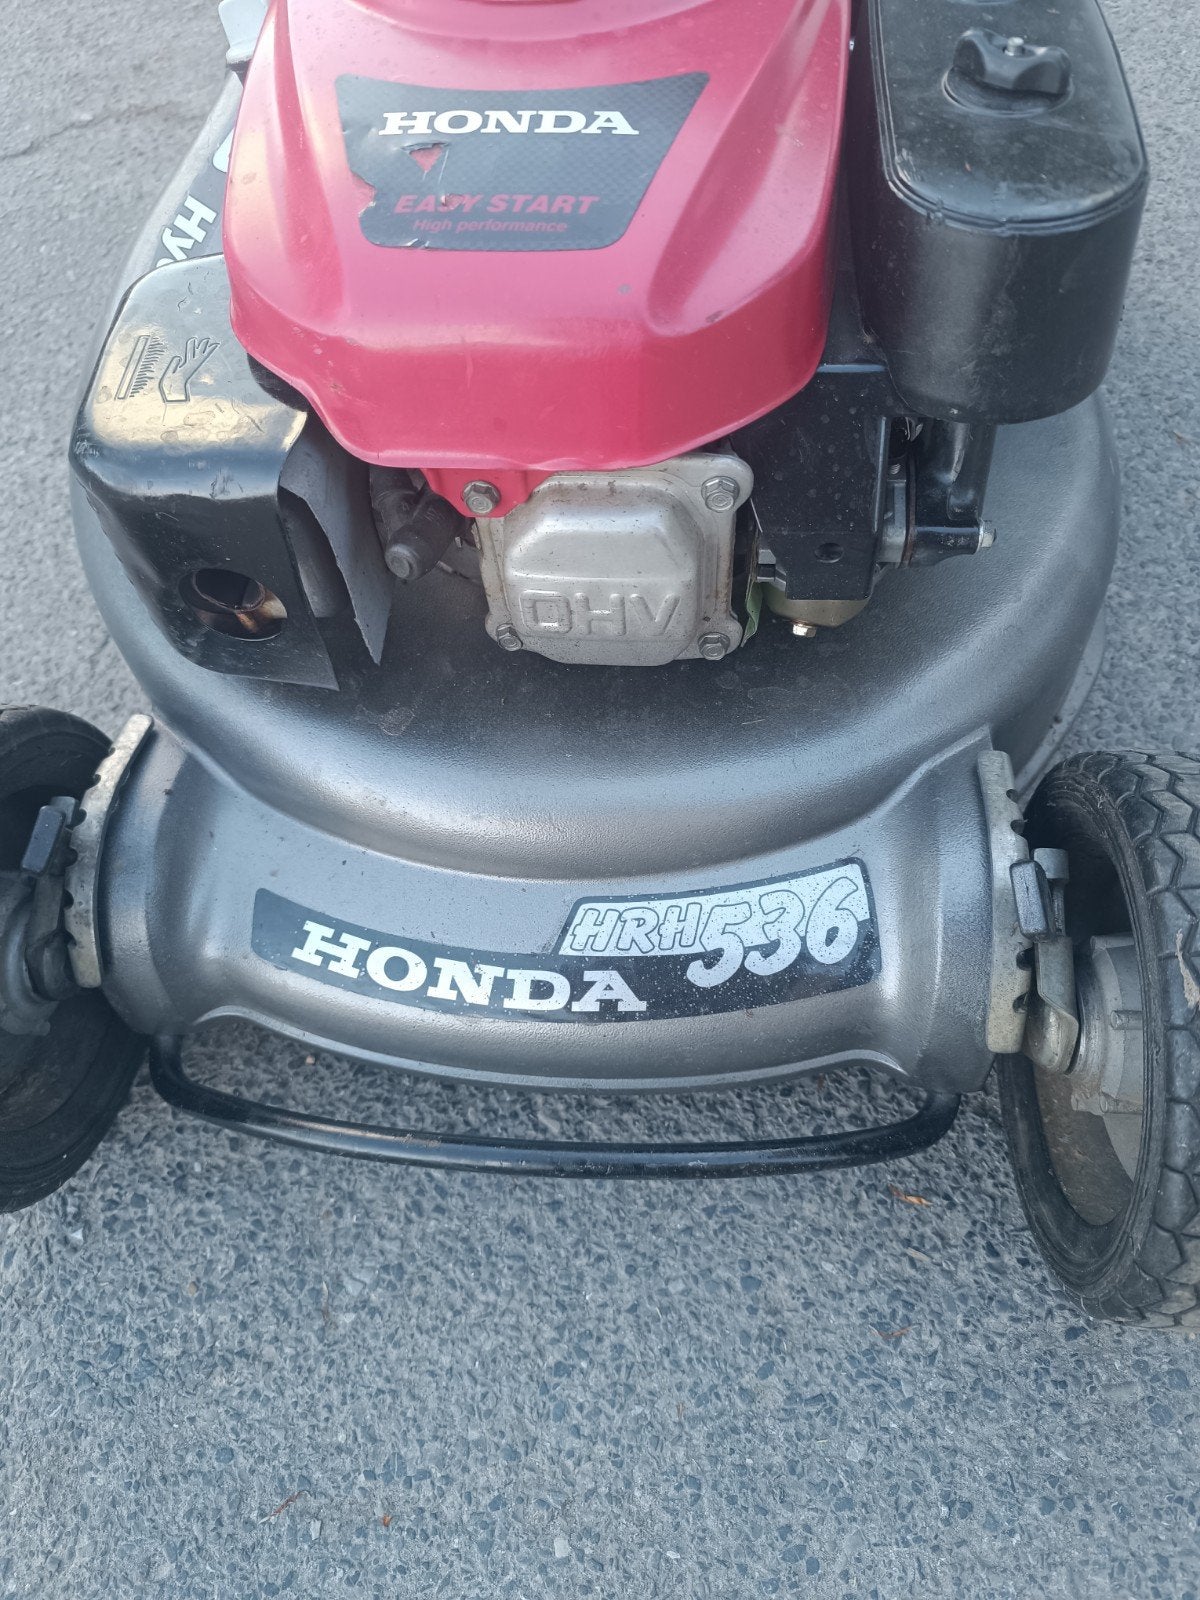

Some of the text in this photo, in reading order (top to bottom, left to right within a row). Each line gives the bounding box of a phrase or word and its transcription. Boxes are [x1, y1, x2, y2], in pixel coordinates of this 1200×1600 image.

[378, 110, 640, 136] HONDA
[486, 194, 600, 215] START
[412, 219, 568, 233] High performance
[519, 590, 681, 637] OHV
[291, 919, 647, 1012] HONDA
